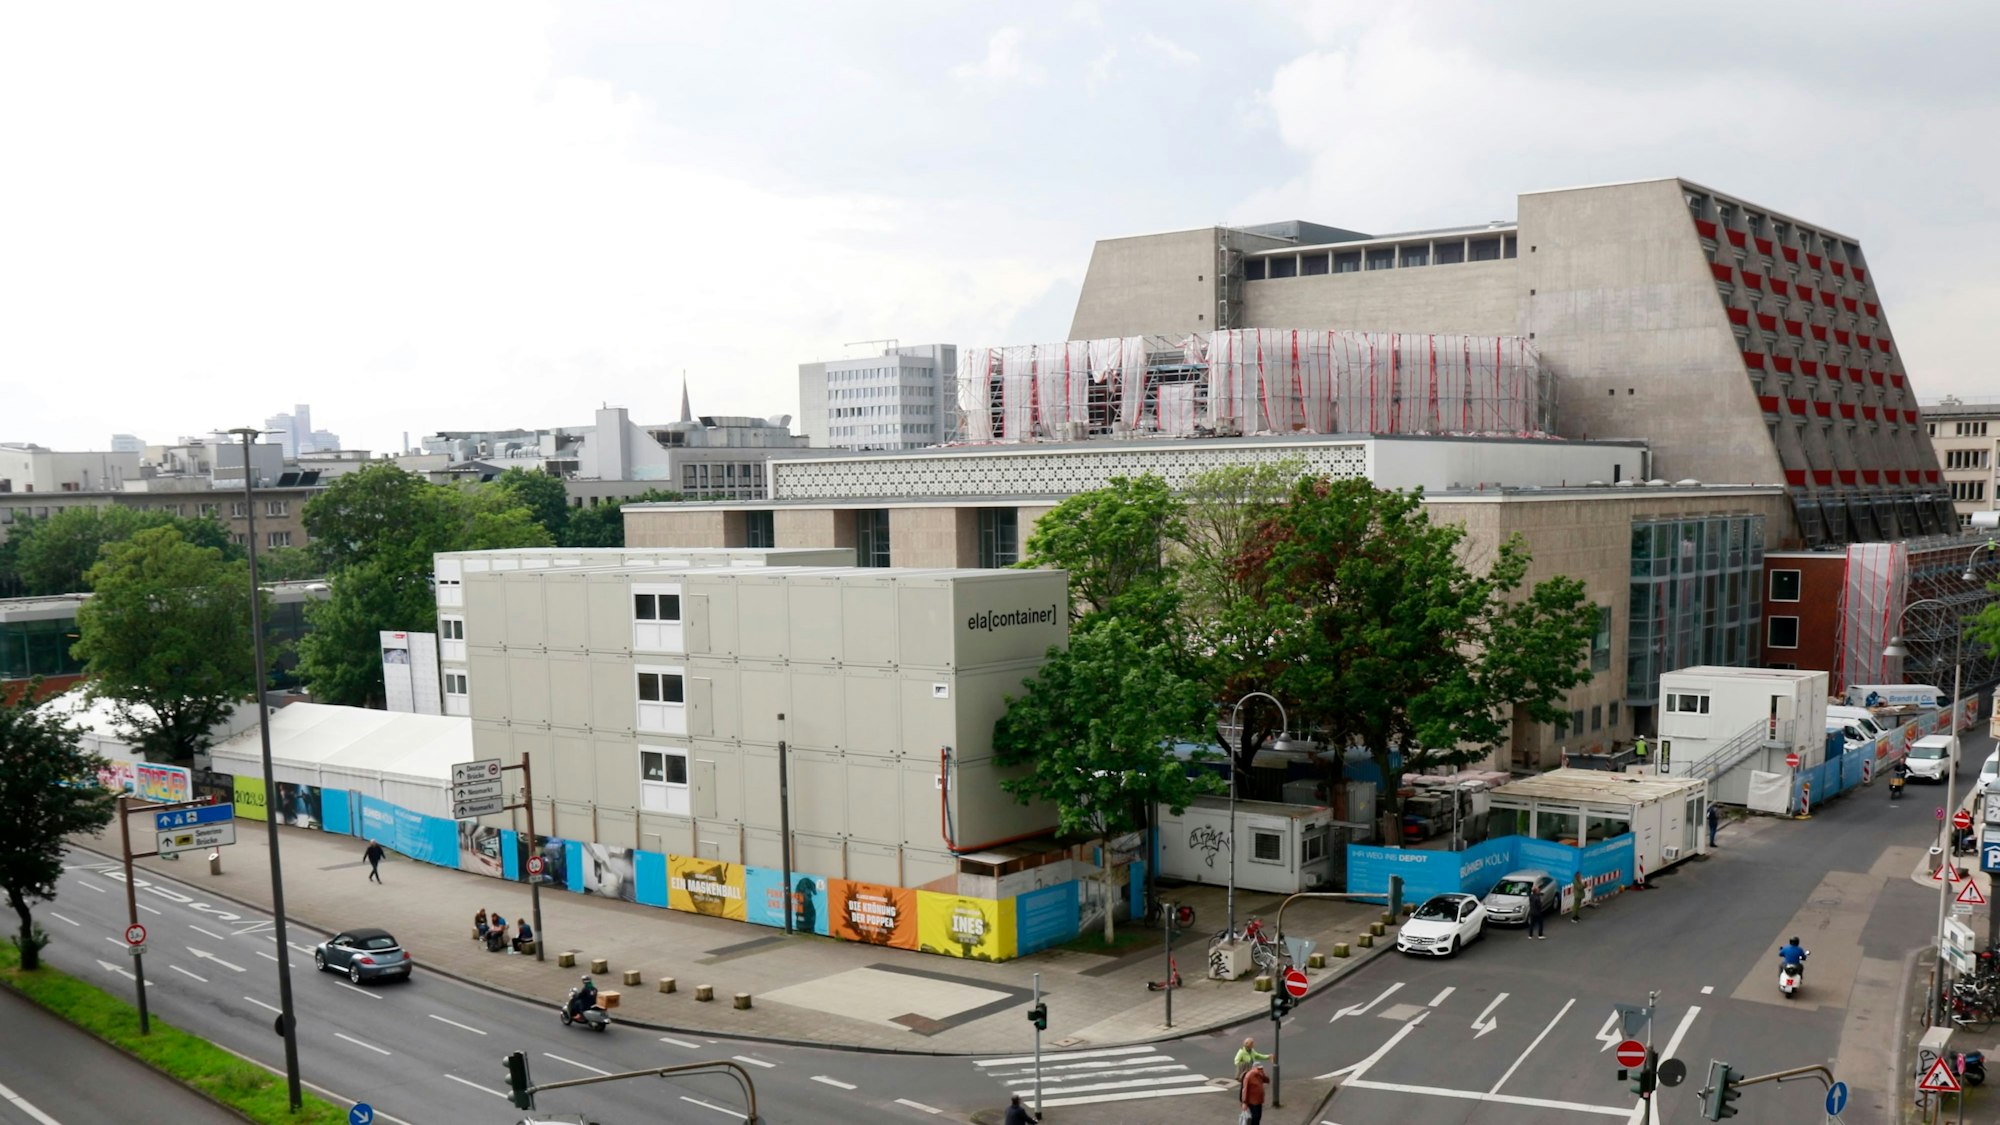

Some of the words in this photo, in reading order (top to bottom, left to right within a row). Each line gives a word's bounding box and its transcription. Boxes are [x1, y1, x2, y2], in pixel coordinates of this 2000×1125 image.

[968, 604, 1056, 631] ela[container]
[235, 790, 268, 807] 2023.2
[1398, 854, 1428, 863] DEPOT
[1484, 852, 1510, 867] KÖLN
[671, 876, 687, 891] EIN
[687, 879, 741, 900] MASKENBALL
[848, 900, 861, 912] DIE
[863, 901, 897, 917] KRÖNUNG
[851, 911, 866, 923] DER
[866, 914, 894, 929] POPPEA
[952, 915, 984, 935] INES
